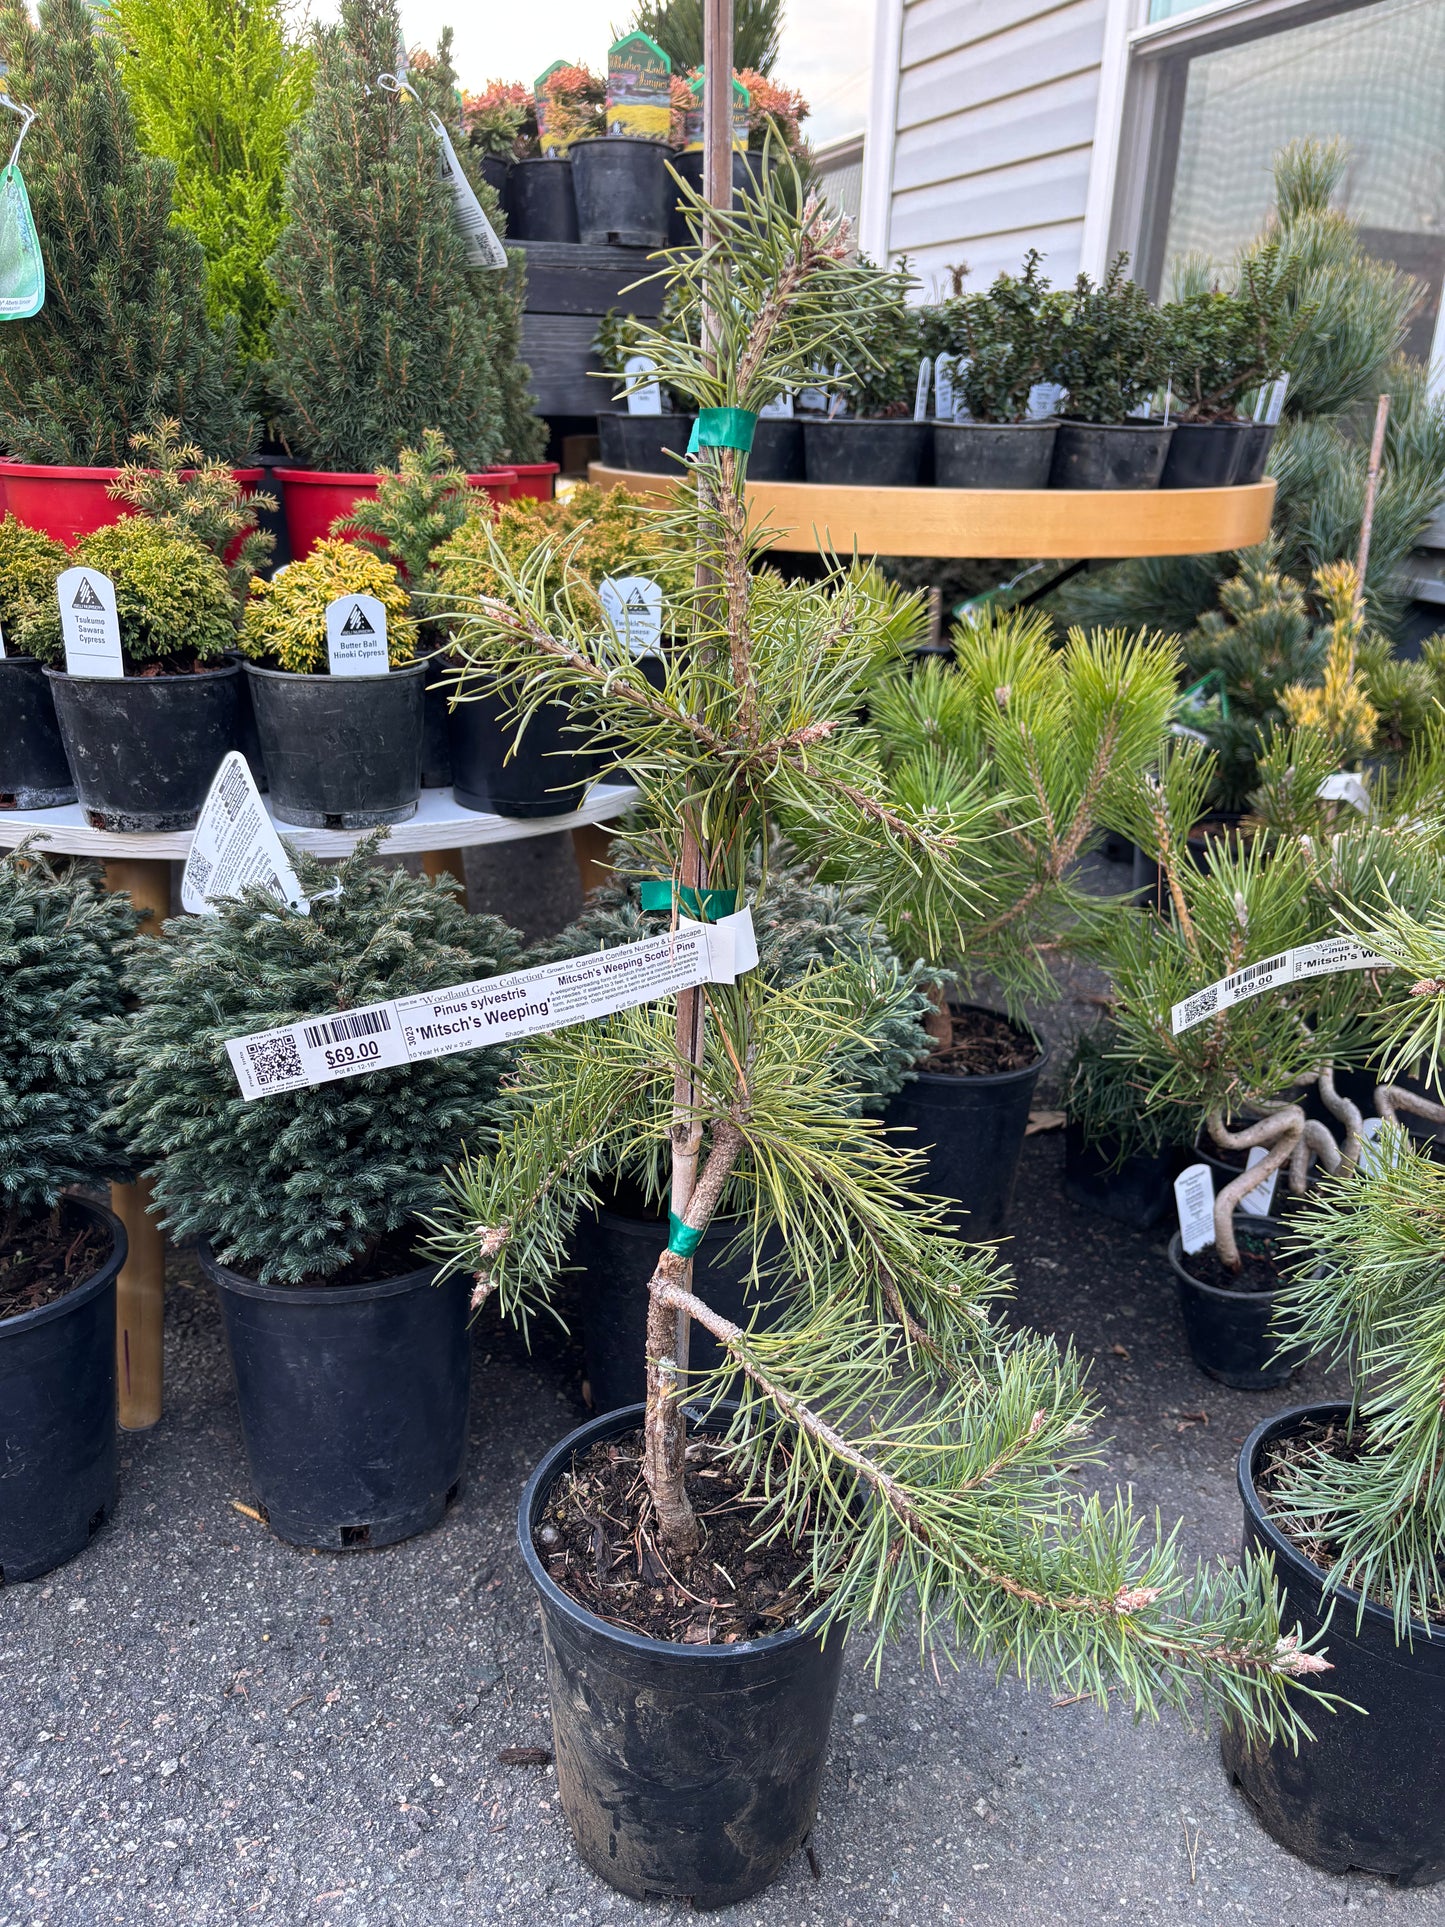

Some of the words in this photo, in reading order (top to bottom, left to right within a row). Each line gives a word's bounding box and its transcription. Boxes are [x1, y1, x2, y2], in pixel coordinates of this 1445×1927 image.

[75, 616, 105, 625] Tsukumo
[78, 625, 104, 634] Sawara
[79, 635, 106, 644] Cypress
[363, 640, 377, 648] Ball
[334, 651, 357, 659] Hinoki
[358, 649, 385, 658] Cypress
[471, 984, 497, 995] Gems
[546, 966, 565, 974] Grown
[575, 956, 604, 967] Carolina
[605, 949, 633, 960] Conifers
[634, 941, 660, 953] Nursery
[667, 929, 701, 943] Lndscape
[558, 968, 601, 986] Mitcsch's
[602, 958, 643, 974] Weeping
[676, 942, 695, 952] Pine
[1303, 952, 1357, 968] 'Mitsch's
[663, 985, 680, 994] USDA
[681, 980, 697, 988] Zones
[1234, 974, 1272, 997] $69.00
[433, 1003, 467, 1017] Pinus
[470, 987, 526, 1010] sylvestris
[415, 1016, 482, 1040] 'Mitsch's
[484, 997, 550, 1025] Weeping'
[505, 1030, 525, 1038] Shape:
[528, 1014, 585, 1032] Prostrate/Spreading
[404, 1026, 416, 1046] 3023
[325, 1041, 378, 1065] $69.00
